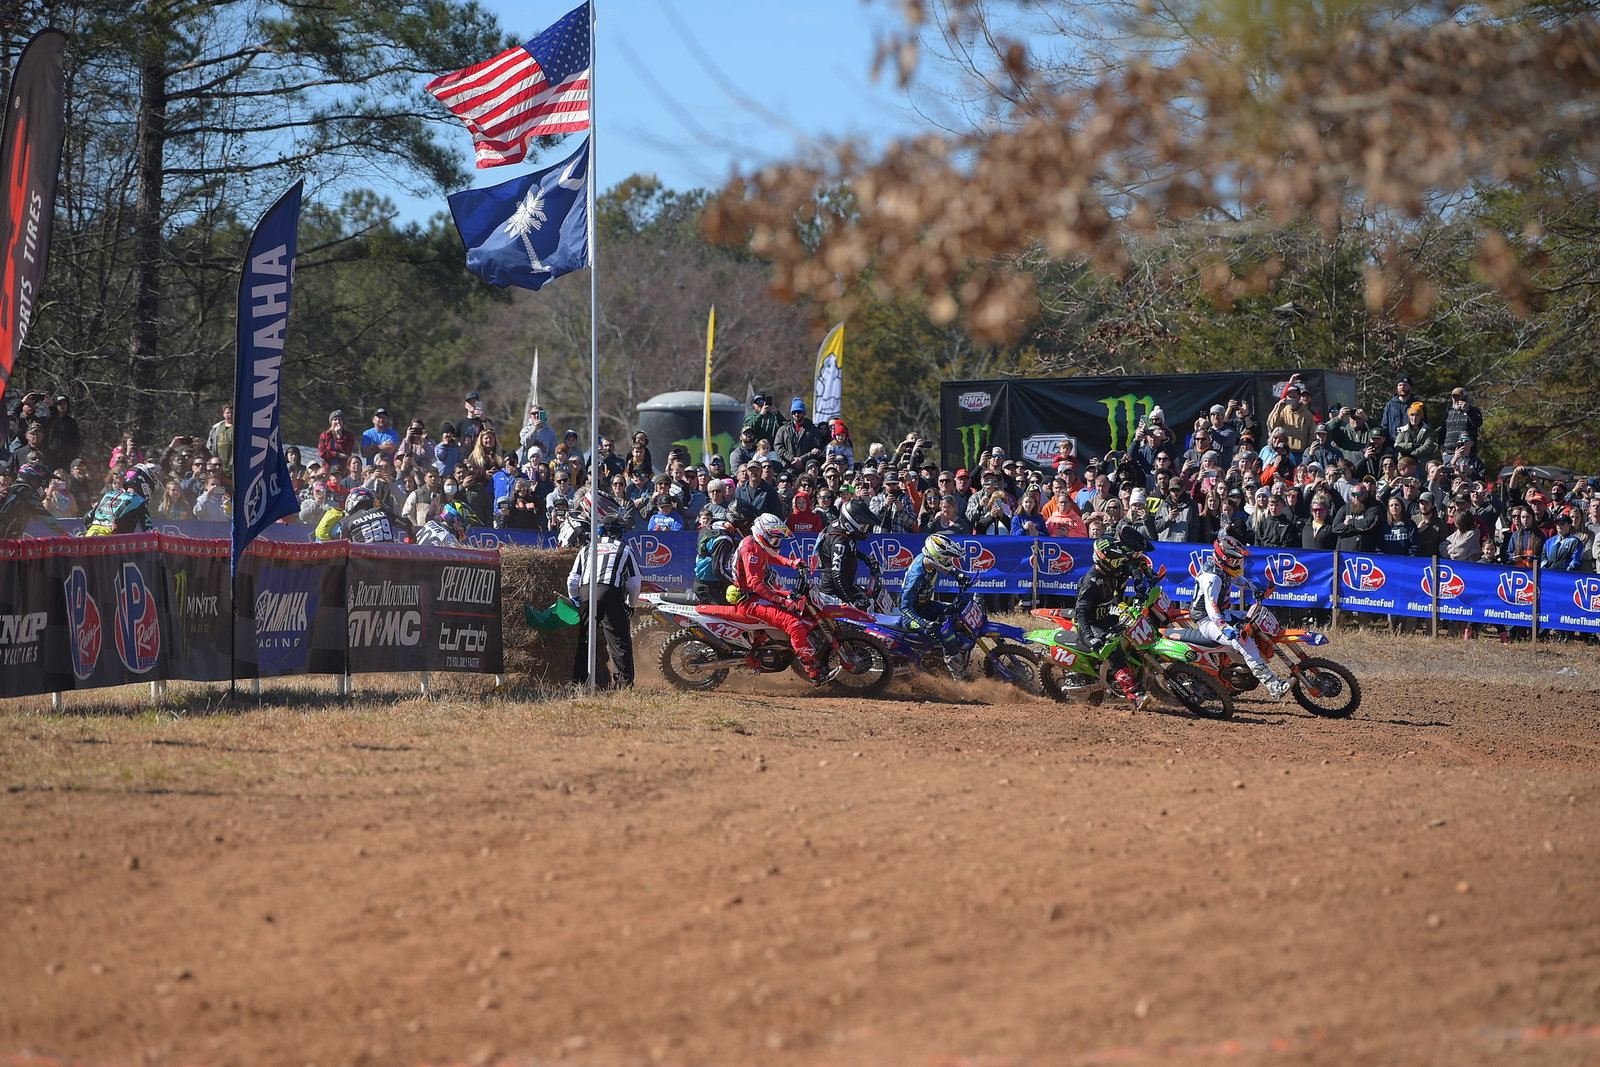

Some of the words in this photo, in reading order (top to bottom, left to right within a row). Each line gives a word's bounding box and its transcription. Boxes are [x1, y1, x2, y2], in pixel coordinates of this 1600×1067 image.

[24, 189, 42, 264] TIRES
[250, 243, 287, 469] YAMAHA
[1025, 441, 1060, 455] GNC
[629, 535, 658, 567] VP
[831, 544, 846, 571] FXR
[1267, 553, 1296, 586] VP
[1345, 557, 1374, 591] VP
[355, 580, 381, 607] ROCKY
[379, 580, 420, 607] MOUNTAIN
[437, 566, 496, 605] SPECIALIZED
[1329, 594, 1395, 608] #oreThanRaceFuel
[1500, 571, 1529, 605] VP
[64, 566, 87, 679] VP
[114, 562, 146, 671] VP
[1407, 602, 1473, 616] #MoreTanRaceFuel
[1484, 608, 1549, 622] #MoreThanRacuel
[439, 622, 488, 653] turbo
[713, 622, 740, 639] 212
[1130, 617, 1153, 645] 114
[1054, 648, 1076, 666] 114
